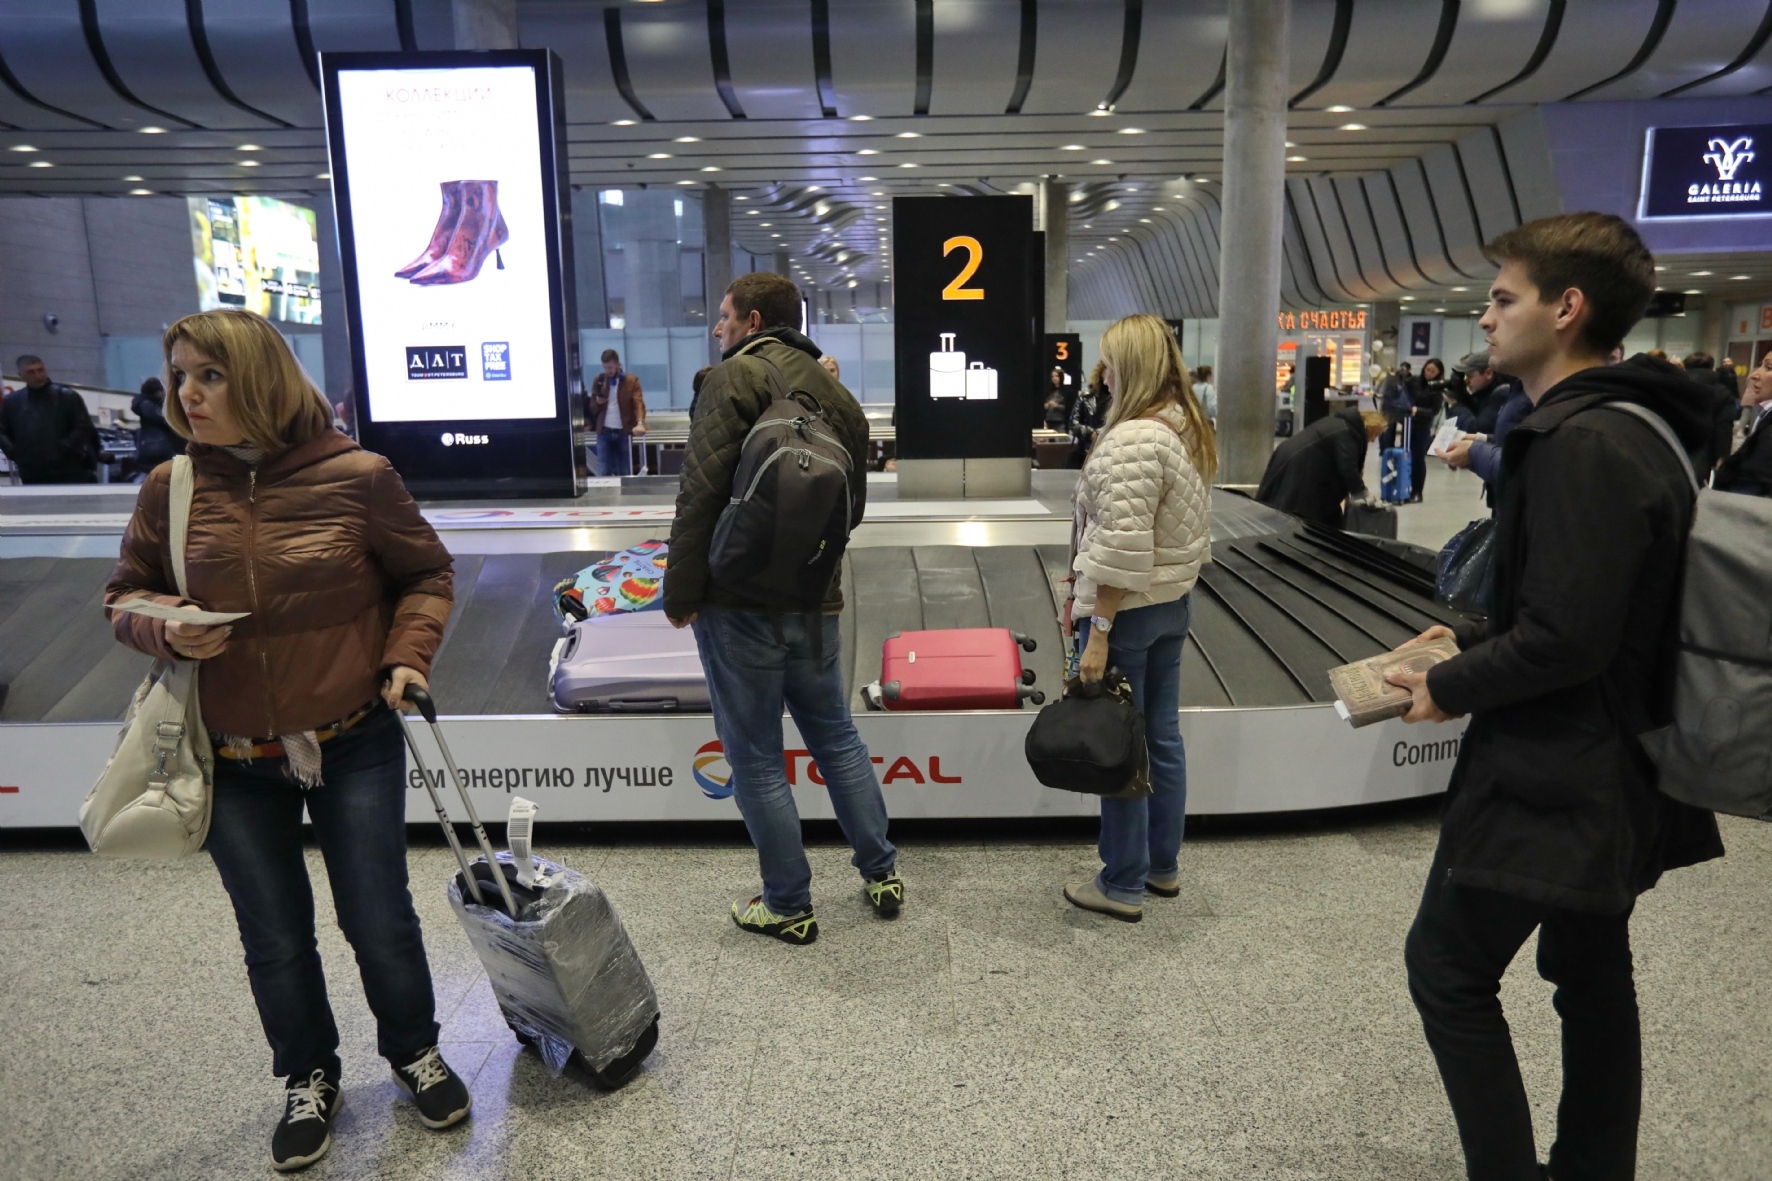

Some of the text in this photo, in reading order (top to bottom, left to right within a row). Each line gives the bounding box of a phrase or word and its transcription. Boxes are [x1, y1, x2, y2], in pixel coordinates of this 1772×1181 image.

[386, 87, 493, 103] КОЛЛЕКЦИИ
[1688, 182, 1761, 195] GALERIA
[1687, 194, 1760, 203] SAINT PETERSBURG
[942, 235, 985, 301] 2
[1299, 310, 1367, 330] СЧАСТЬЯ
[483, 344, 507, 353] SHOP
[1055, 341, 1069, 360] 3
[484, 353, 502, 362] TAX
[485, 361, 507, 370] FREE
[455, 433, 489, 445] Russ
[634, 559, 654, 575] CHATTE
[406, 766, 673, 793] ем энергию лучше
